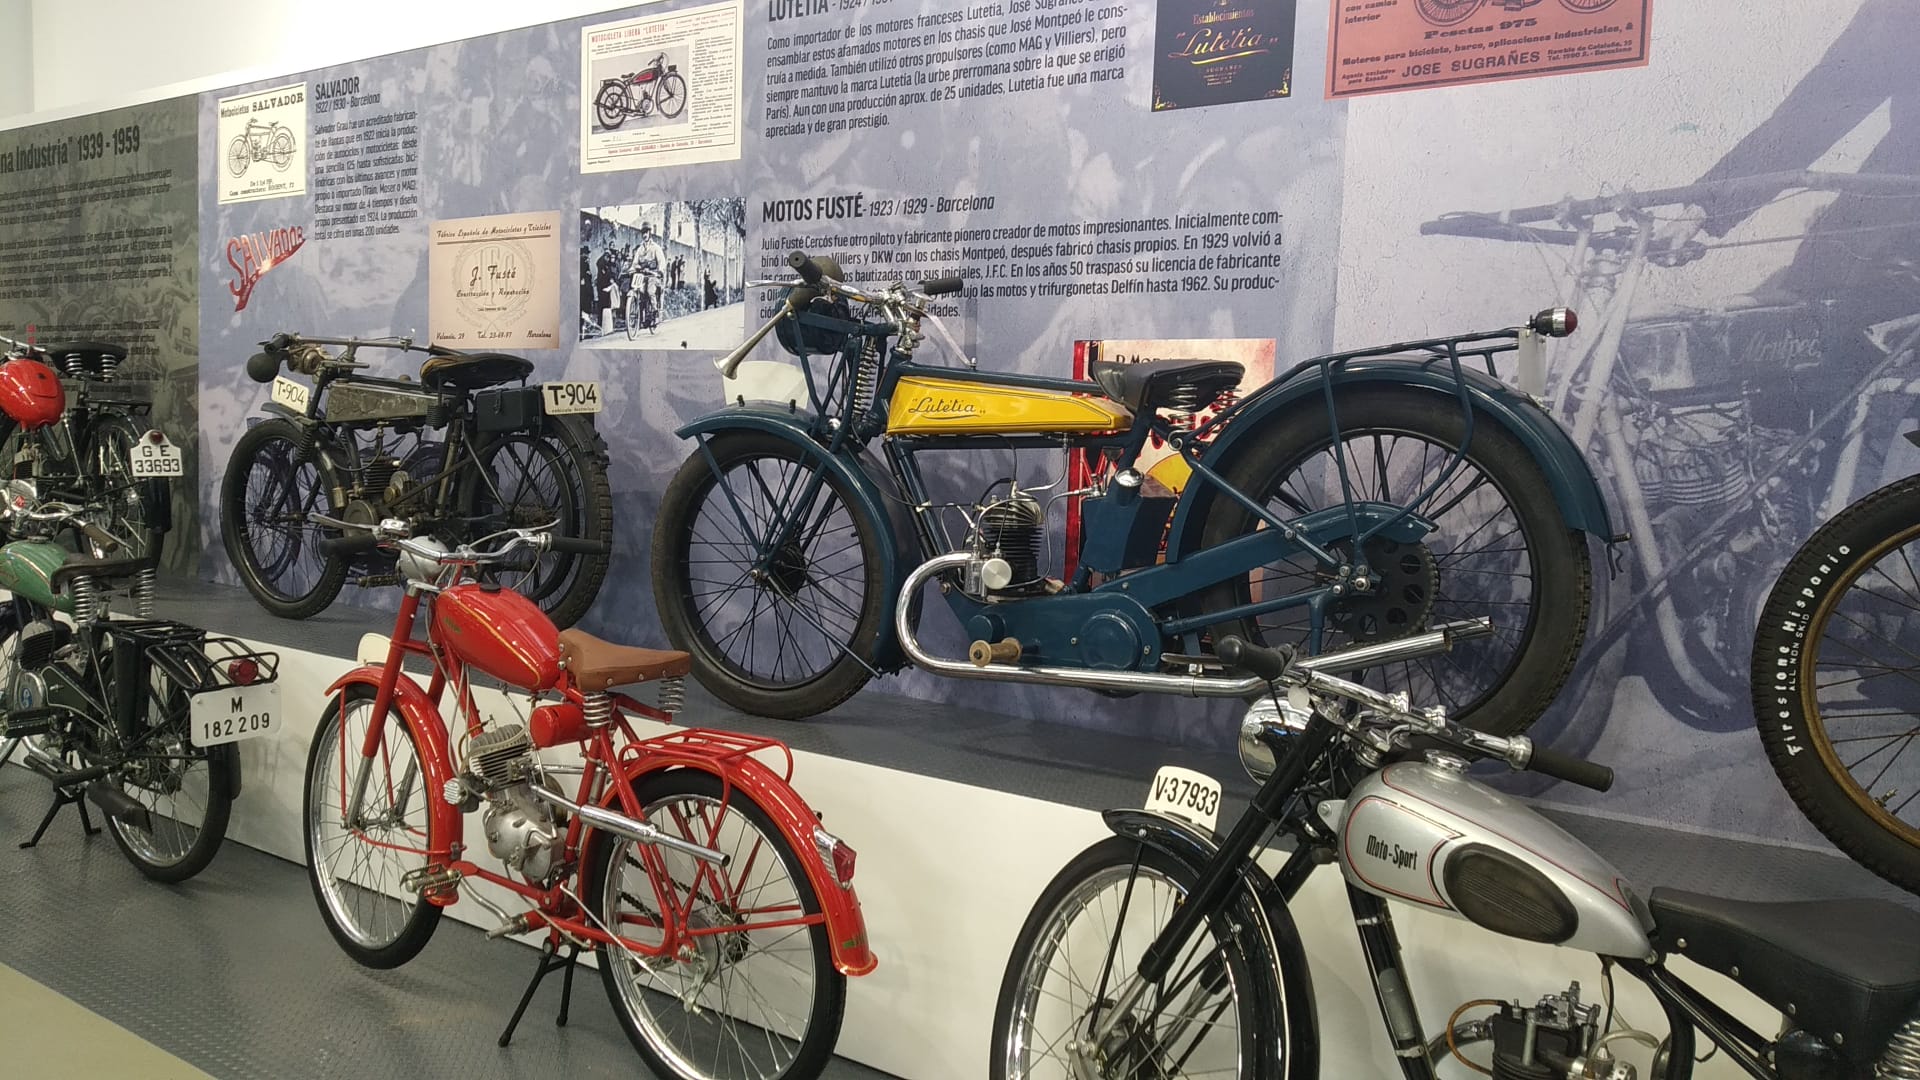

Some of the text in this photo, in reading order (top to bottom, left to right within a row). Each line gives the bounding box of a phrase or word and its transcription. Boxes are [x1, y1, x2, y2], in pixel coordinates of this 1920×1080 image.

[766, 6, 1127, 67] ensamblar estos afamados motores chasis José Montpeó cons-
[767, 0, 1031, 50] Como importador motores franceses Lutetia, José
[1424, 18, 1537, 39] Pesetas 975
[766, 28, 1126, 85] truía medida. También utilizó otros propulsores (como MAG Villiers), pero
[1402, 63, 1441, 78] JOSE
[1451, 48, 1540, 72] SUGRAÑES
[766, 45, 1125, 103] siempre mantuvo marca Lutetia urbe prerromana sobre erigió
[315, 76, 360, 100] SALVADOR
[350, 93, 381, 108] Barcelona
[766, 69, 1124, 120] París). producción aprox. 25 unidades, Lutetia marca
[252, 92, 304, 112] SALVADOR
[765, 113, 889, 139] apreciada gran prestigio.
[78, 131, 103, 161] 1939
[112, 125, 140, 155] 1959
[762, 200, 812, 223] MOTOS
[869, 201, 893, 217] 1923
[902, 198, 928, 215] 1929
[936, 196, 994, 213] Barcelona
[761, 213, 1282, 249] Julio Fusté Cercós otro piloto fabricante pionero creador motos impresionantes. Inicialmente com-
[871, 249, 893, 263] DKW
[930, 247, 959, 261] chasis
[962, 245, 1008, 262] Montpeó,
[1010, 243, 1053, 261] después
[1055, 241, 1093, 256] fabricó
[1096, 240, 1131, 254] chasis
[1133, 238, 1179, 256] propios.
[1202, 234, 1228, 249] 1929
[1232, 232, 1270, 247] volvió
[488, 265, 517, 281] Fusté
[854, 267, 903, 282] bautizadas
[985, 264, 1007, 278] J.F.C.
[1042, 262, 1067, 276] años
[1069, 261, 1083, 275] 50
[1085, 259, 1133, 277] traspasó
[1151, 257, 1196, 272] licencia
[1216, 255, 1280, 269] fabricante
[996, 285, 1027, 297] motos
[1038, 282, 1108, 298] trifurgonetas
[1110, 279, 1144, 293] Delfín
[1146, 279, 1178, 292] hasta
[1181, 277, 1210, 291] 1962.
[1230, 275, 1279, 293] produc-
[277, 380, 304, 405] T-904
[547, 383, 597, 406] T-904
[134, 459, 180, 473] 33693
[1789, 613, 1810, 692] ALL NON SKID
[231, 696, 242, 713] M
[1366, 834, 1418, 871] Moto-Sport
